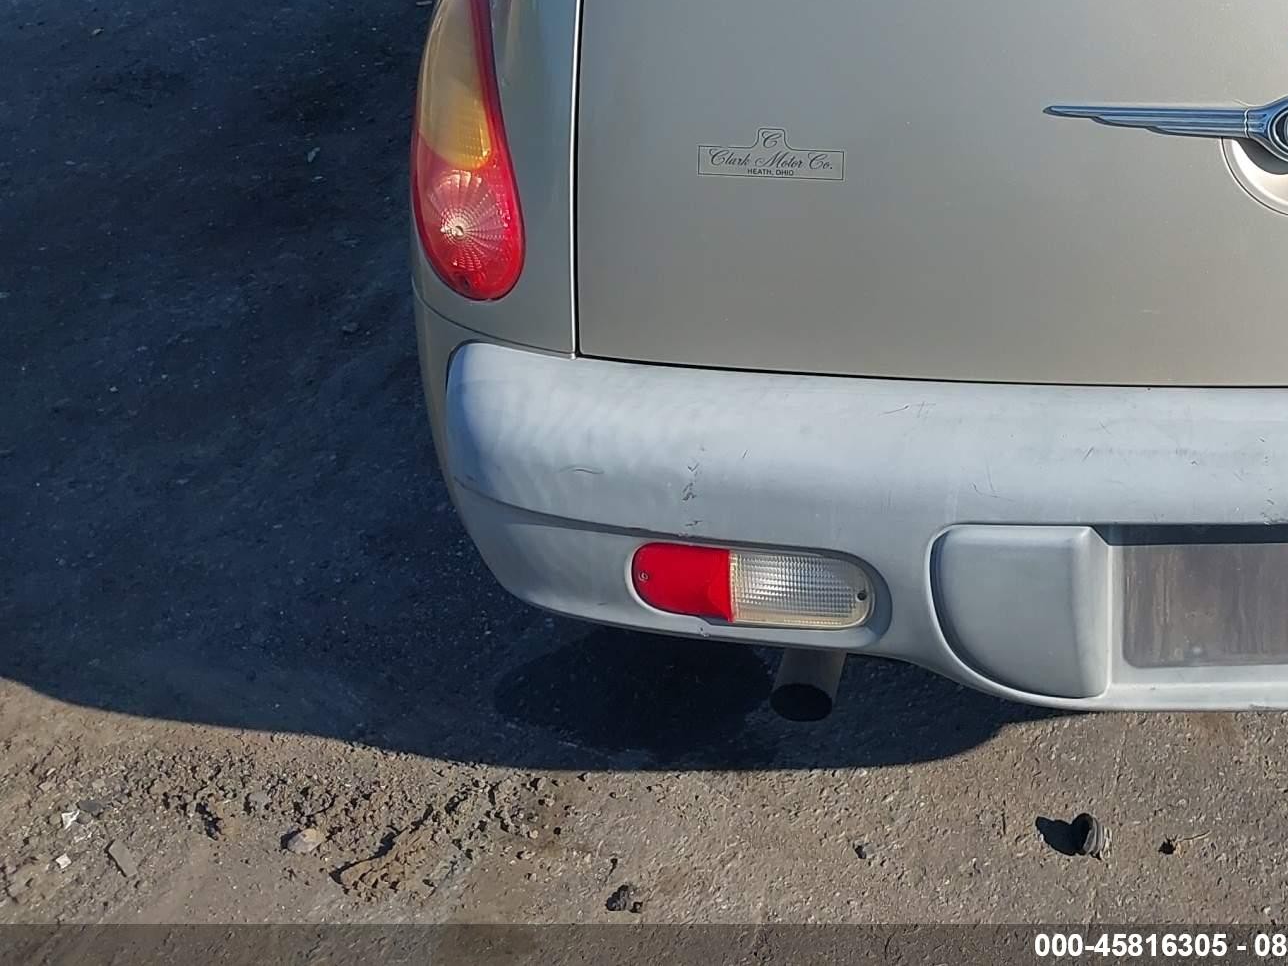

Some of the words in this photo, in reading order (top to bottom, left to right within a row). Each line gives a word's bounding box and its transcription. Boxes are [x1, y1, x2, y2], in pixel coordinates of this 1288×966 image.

[761, 131, 783, 148] C
[709, 149, 751, 166] Clark
[754, 151, 803, 169] Motor
[808, 152, 833, 170] Co.
[747, 167, 775, 176] HEATH,
